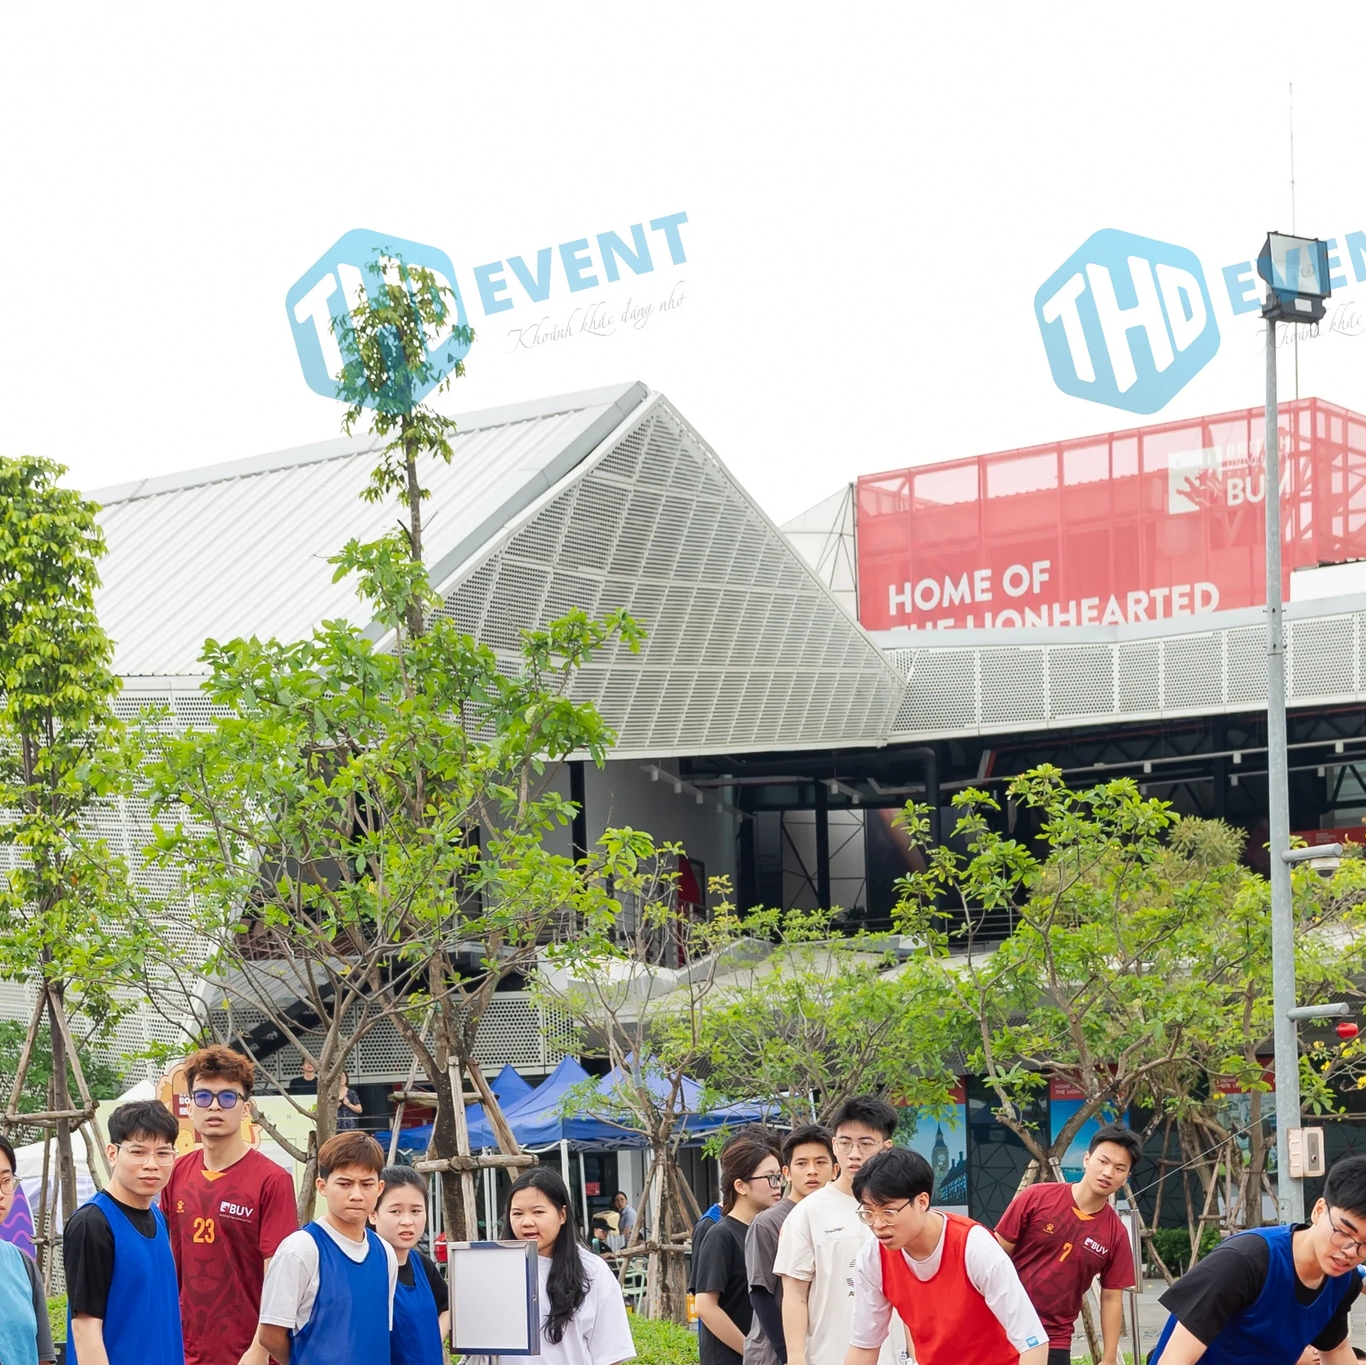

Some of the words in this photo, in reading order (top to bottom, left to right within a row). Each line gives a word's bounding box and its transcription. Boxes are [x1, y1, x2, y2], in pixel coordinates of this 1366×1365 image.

[888, 568, 993, 616] HOME
[1001, 559, 1051, 598] OF
[229, 1203, 254, 1218] BUV
[192, 1217, 216, 1244] 23
[1059, 1242, 1074, 1263] 7
[1091, 1242, 1109, 1256] BUV
